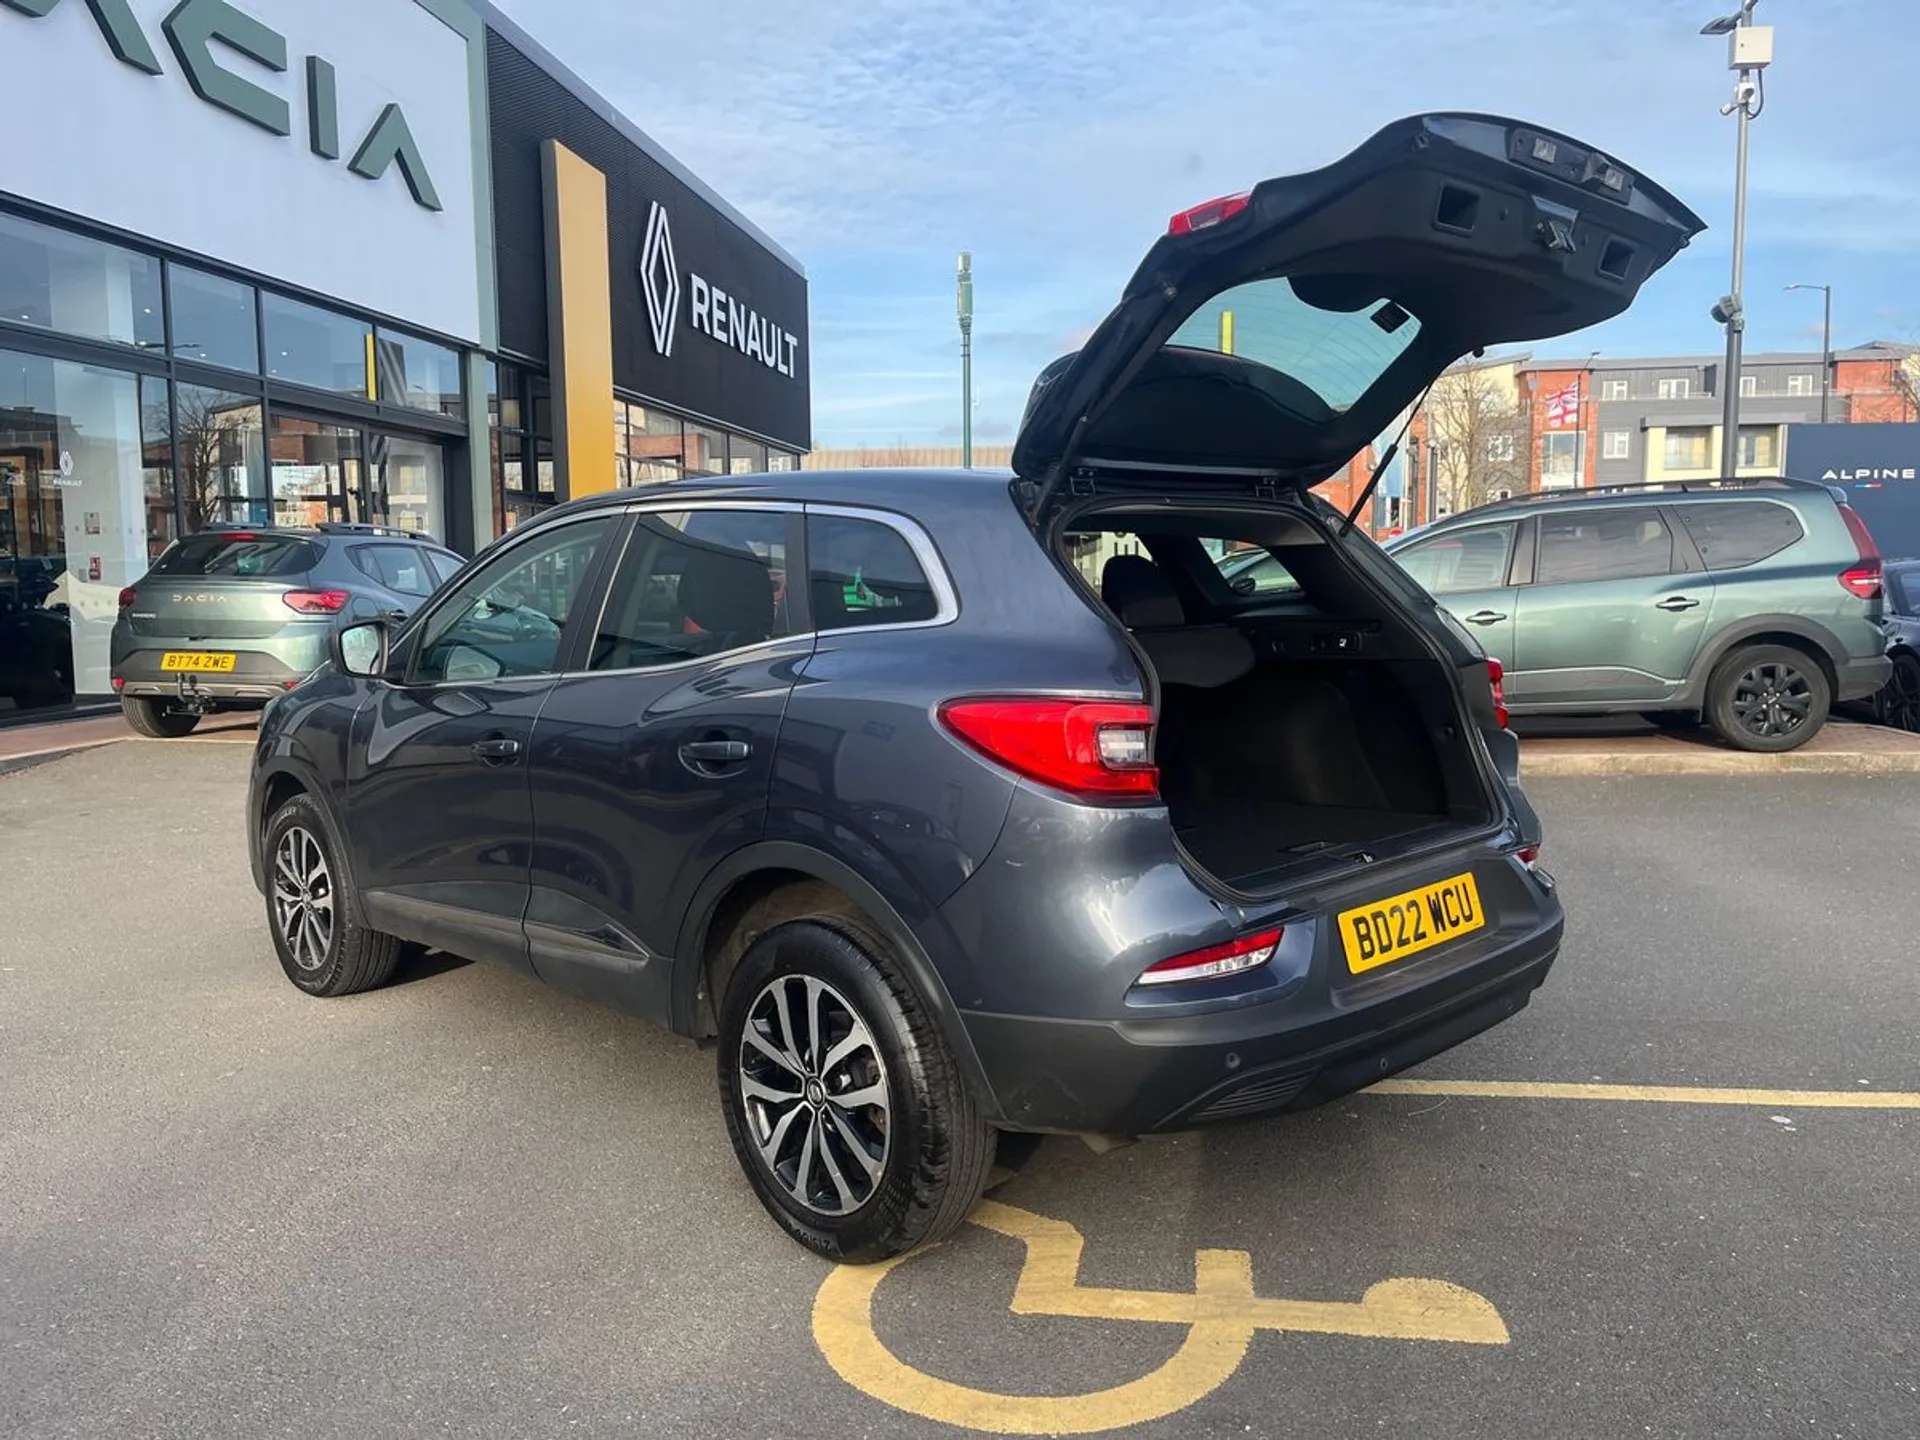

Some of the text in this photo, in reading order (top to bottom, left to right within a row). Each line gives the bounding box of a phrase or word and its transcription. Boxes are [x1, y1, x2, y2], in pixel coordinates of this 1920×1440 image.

[690, 273, 798, 378] RENAULT
[1822, 468, 1916, 480] ALPINE
[172, 594, 226, 602] DACIA
[167, 655, 230, 669] BT74 ZWE
[1352, 883, 1473, 960] BD22 WCU
